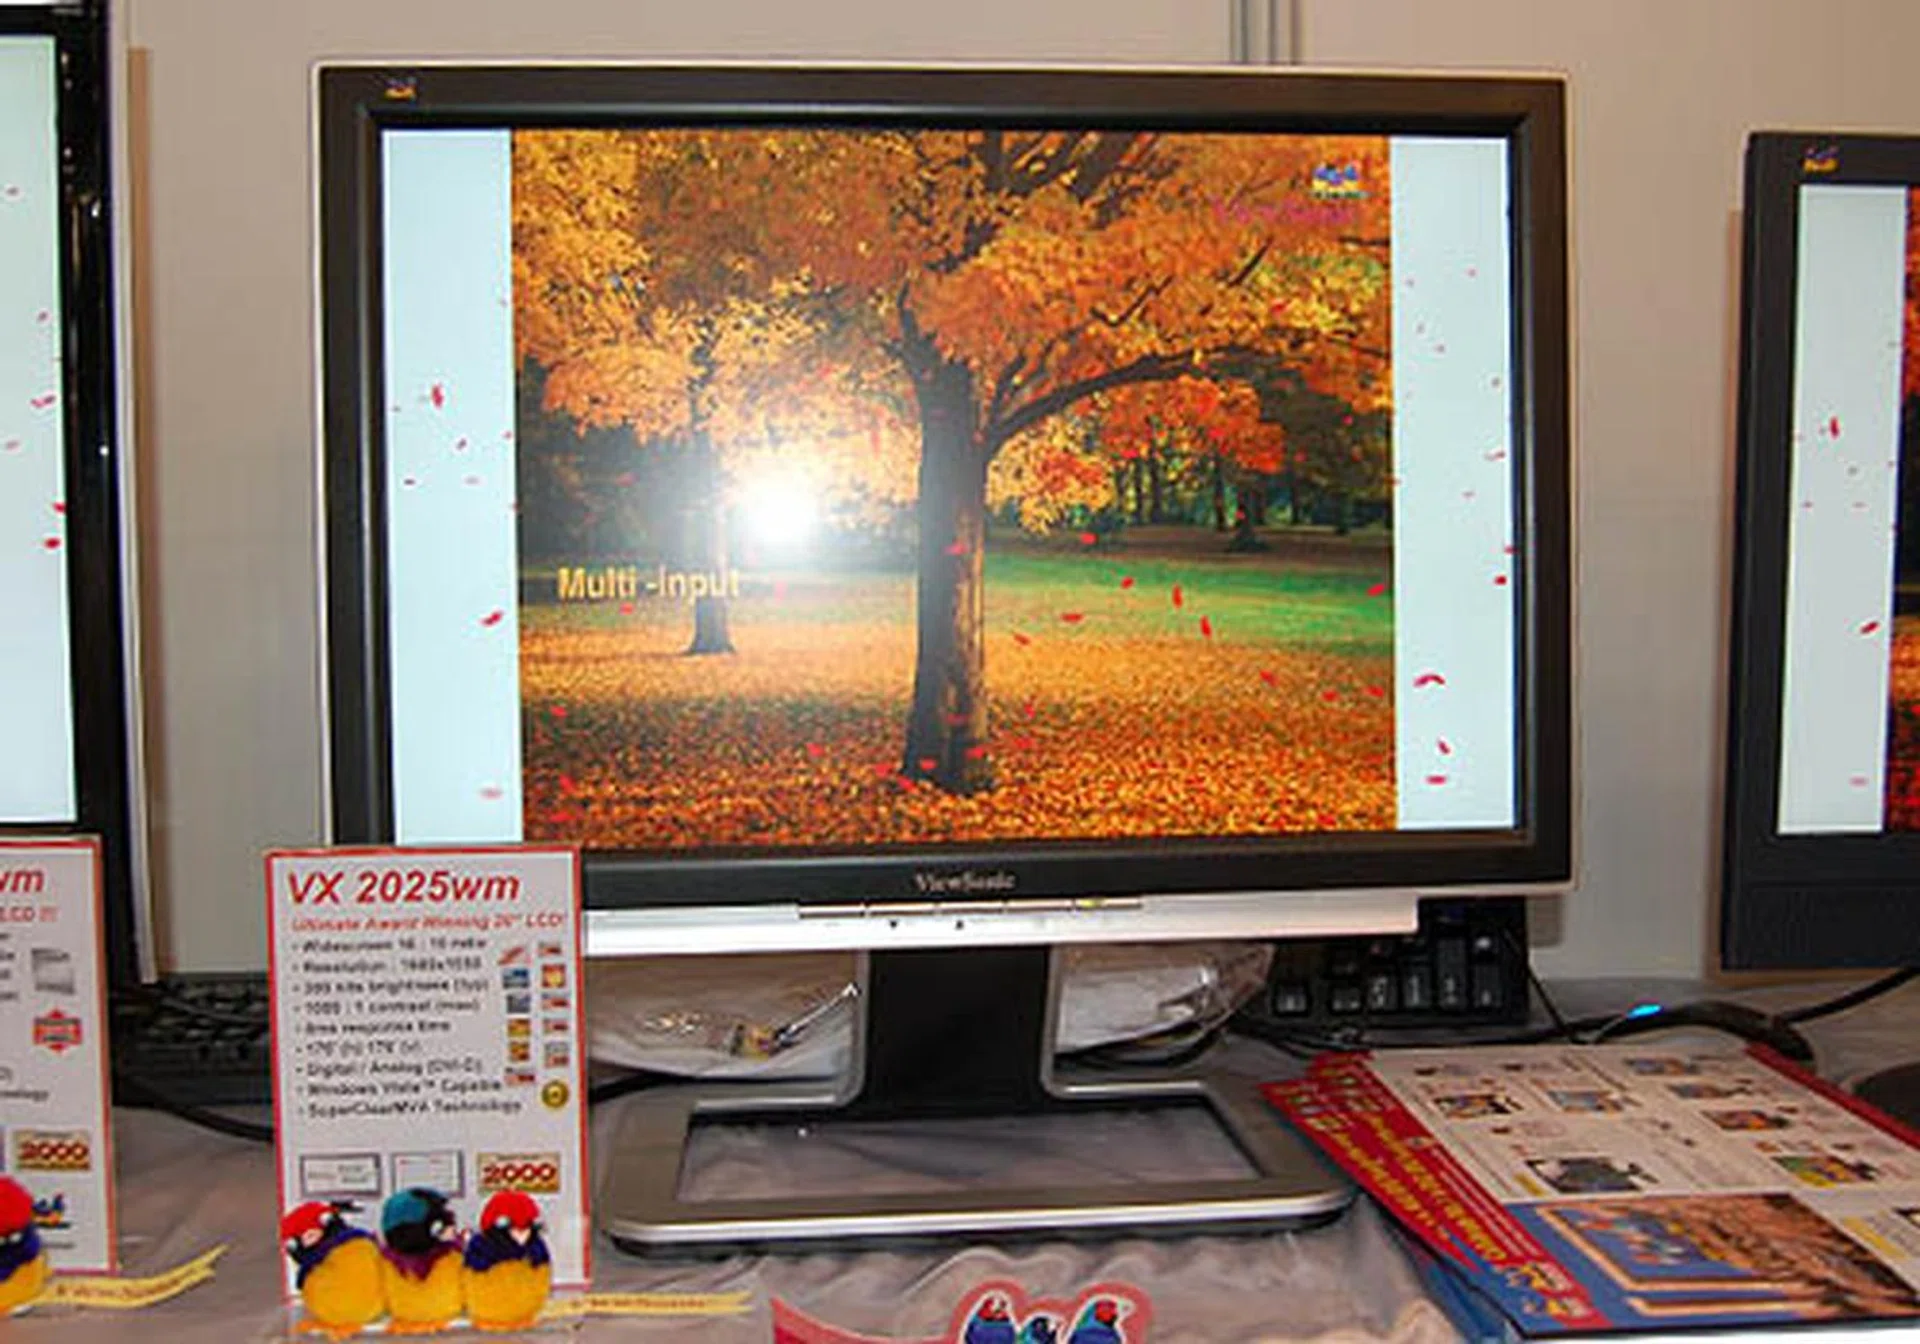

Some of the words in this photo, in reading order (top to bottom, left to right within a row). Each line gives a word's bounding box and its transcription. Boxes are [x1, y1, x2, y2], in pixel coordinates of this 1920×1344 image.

[557, 566, 637, 598] Multi
[287, 870, 345, 904] VX
[356, 868, 521, 904] 2025wm
[482, 1163, 556, 1186] 2000
